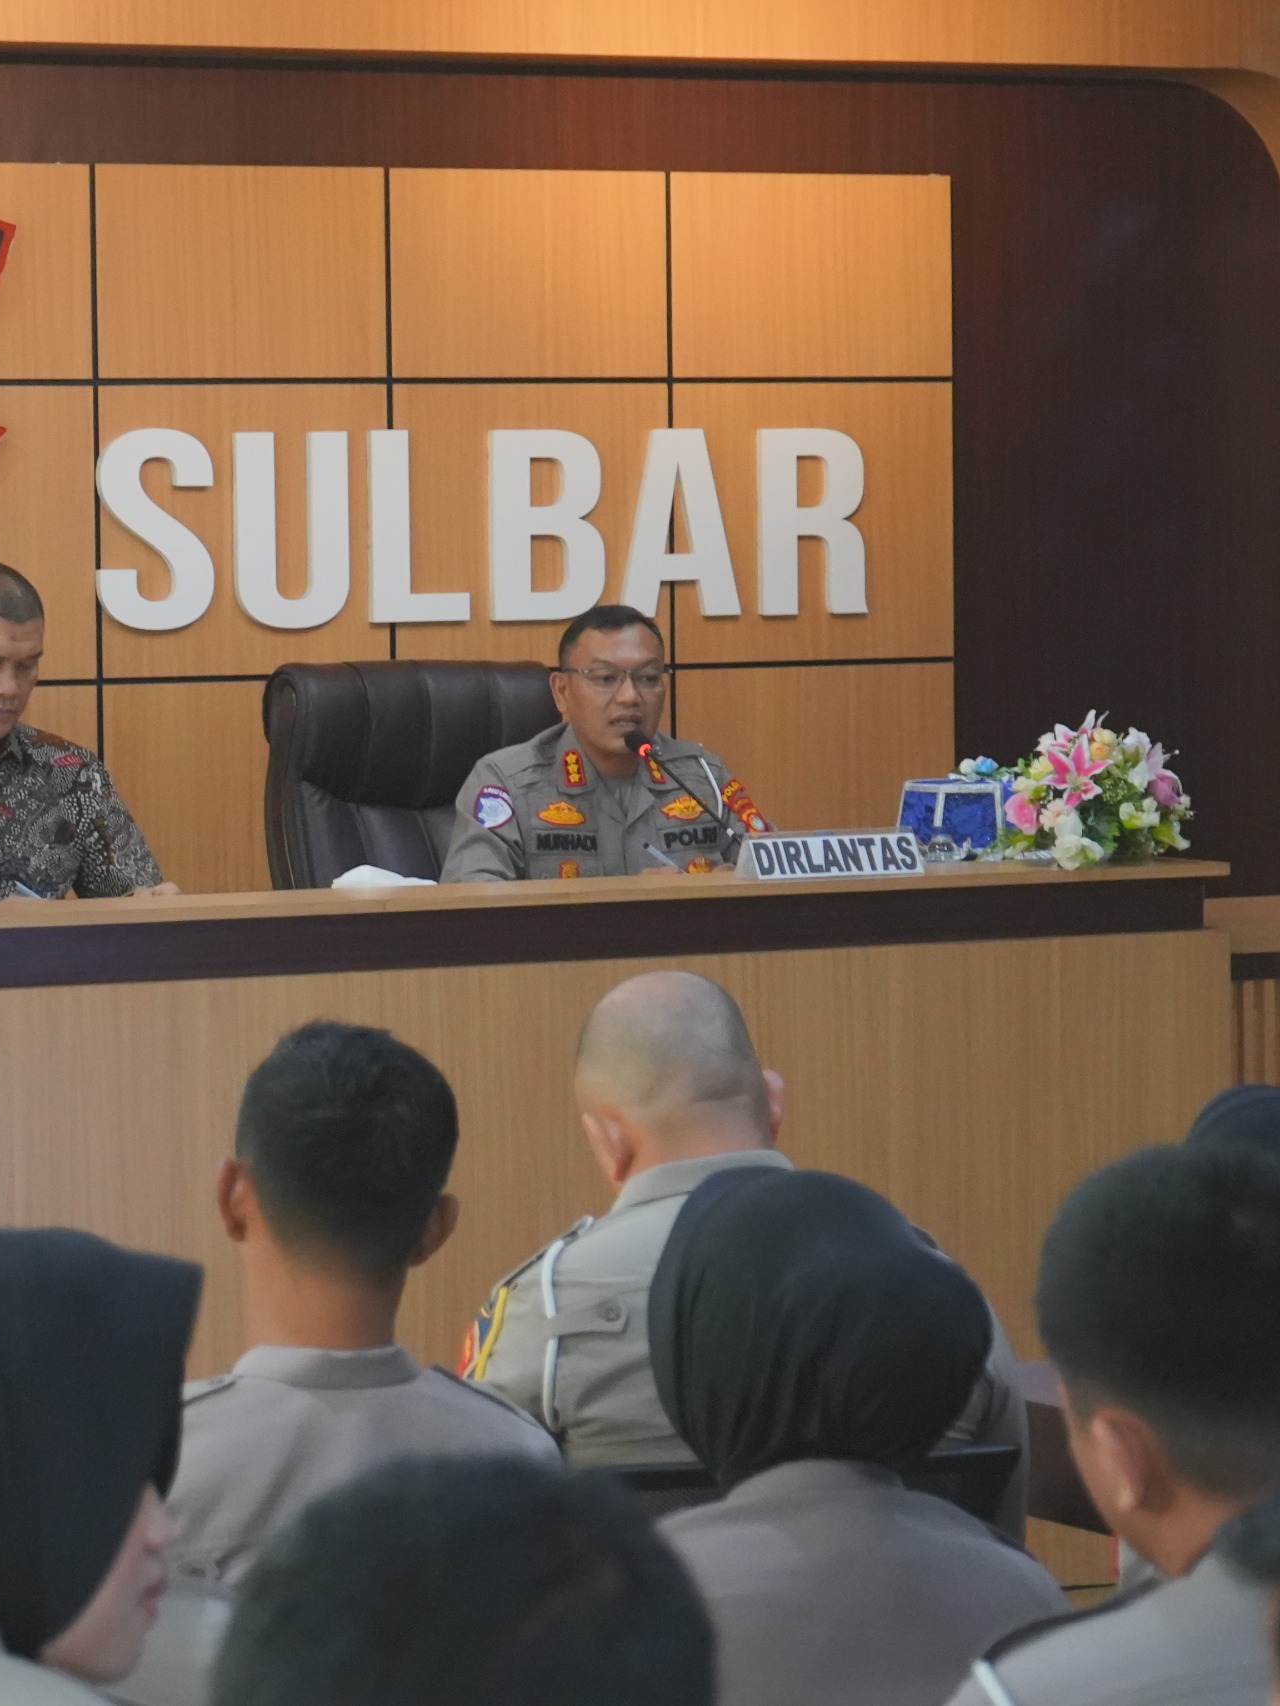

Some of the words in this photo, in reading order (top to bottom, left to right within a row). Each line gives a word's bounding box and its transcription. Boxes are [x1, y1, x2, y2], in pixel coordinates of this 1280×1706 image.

[94, 427, 869, 631] SULBAR
[663, 825, 718, 849] POLRI
[752, 836, 918, 876] DIRLANTAS
